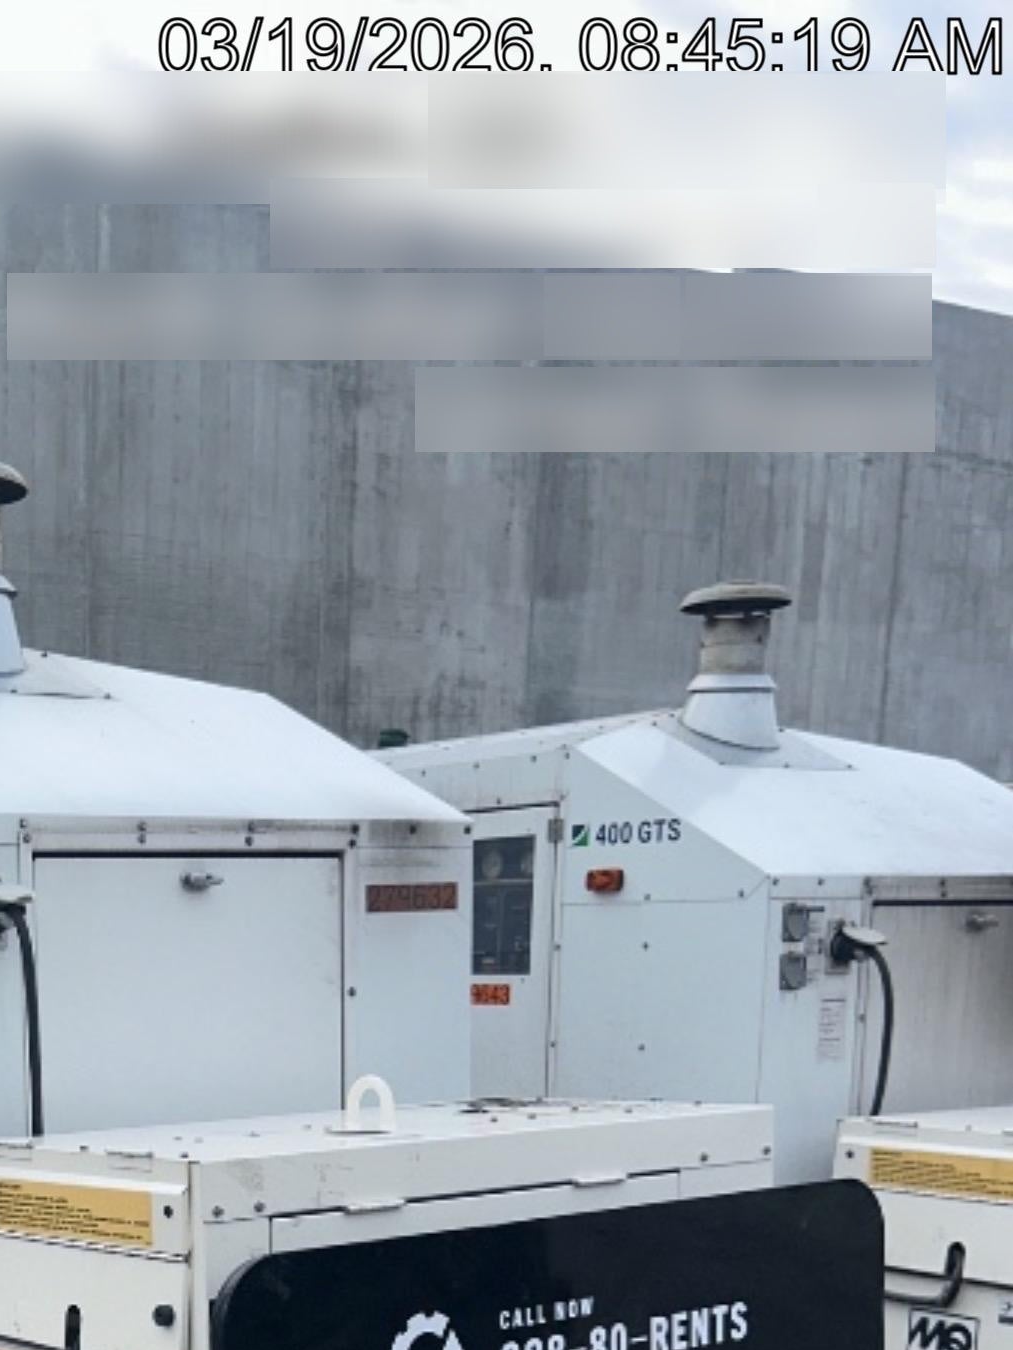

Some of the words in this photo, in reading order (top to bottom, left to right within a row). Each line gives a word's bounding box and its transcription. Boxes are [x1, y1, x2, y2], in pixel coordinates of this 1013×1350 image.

[595, 822, 633, 846] 400
[637, 818, 682, 844] GTS
[499, 1306, 547, 1330] CALL
[553, 1296, 595, 1322] NOW
